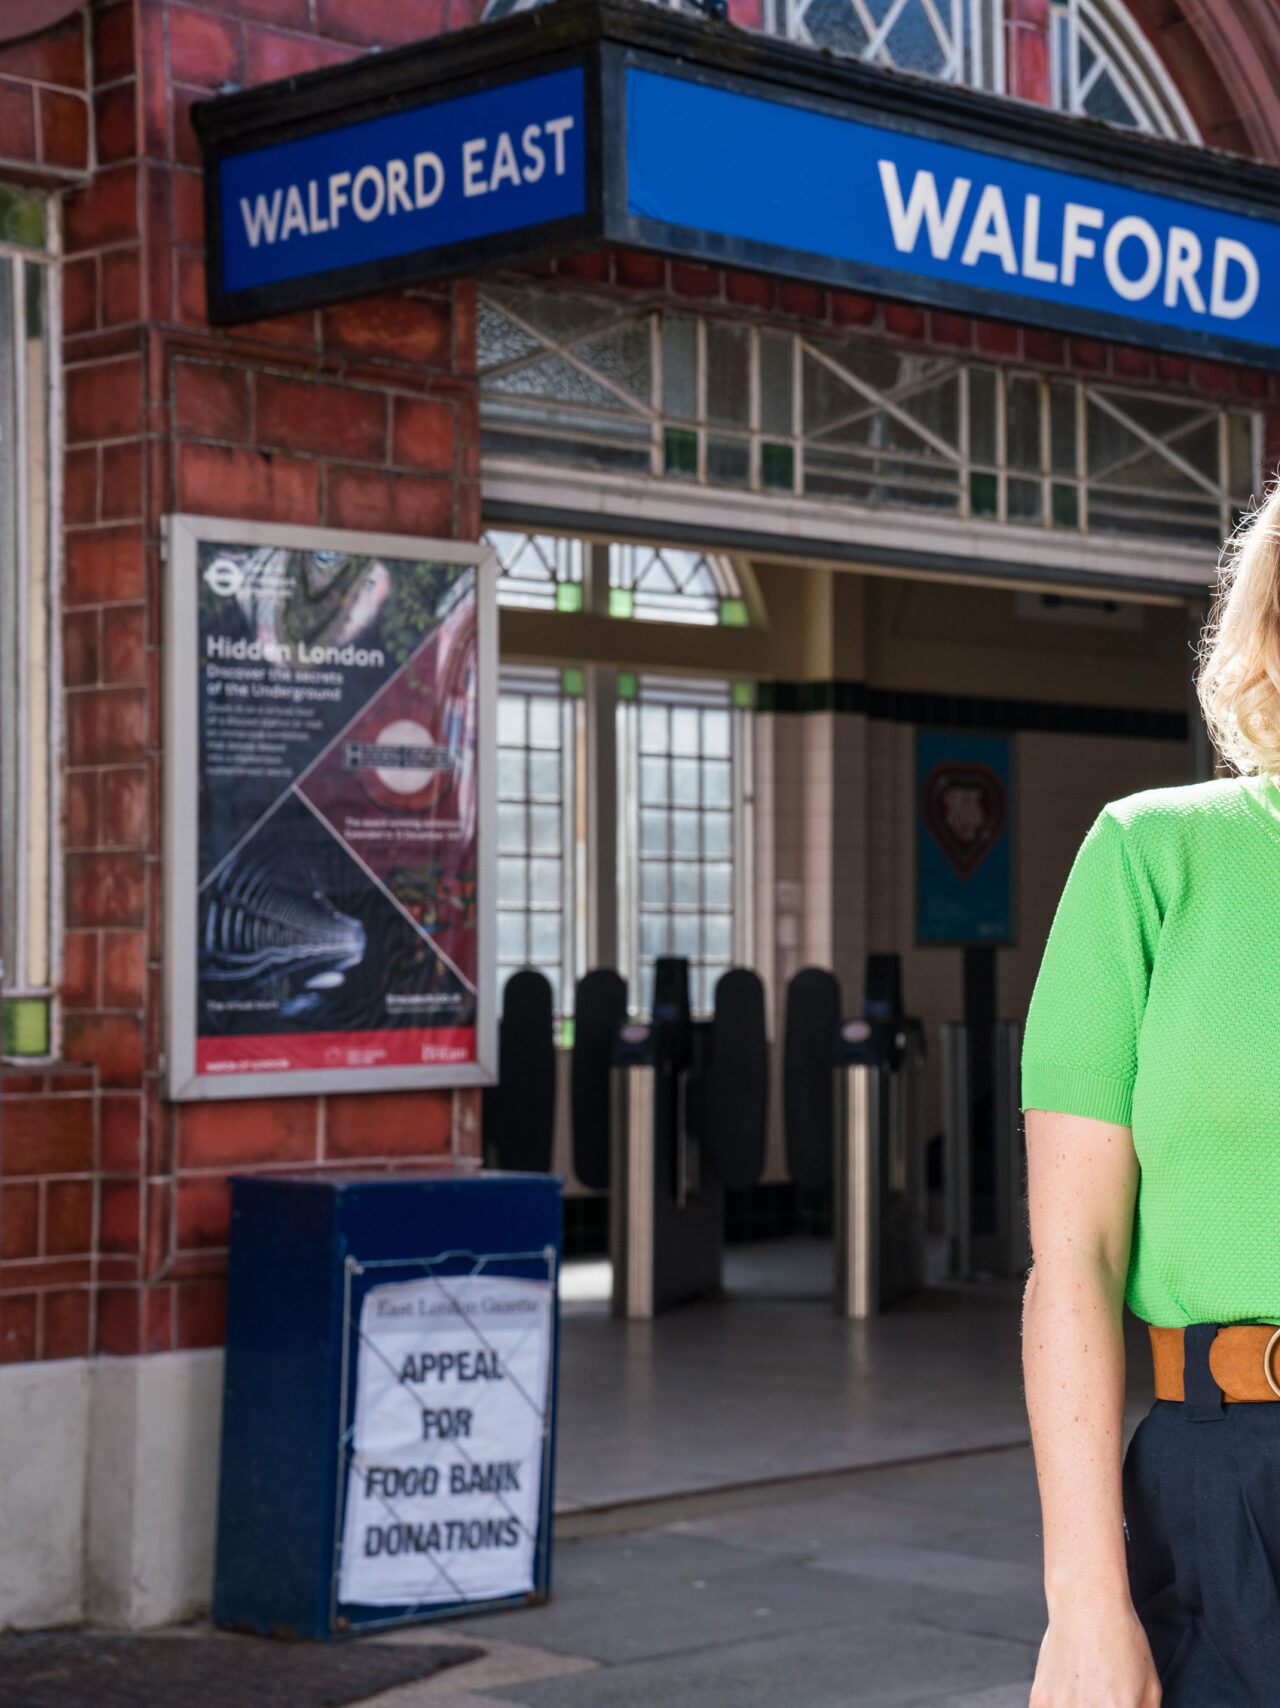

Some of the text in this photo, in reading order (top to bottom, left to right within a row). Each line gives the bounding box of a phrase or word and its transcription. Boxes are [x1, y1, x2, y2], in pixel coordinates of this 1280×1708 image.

[239, 115, 574, 248] WALFORD EAST
[877, 158, 1260, 320] WALFORD
[206, 635, 385, 668] Hidden London
[206, 663, 344, 685] Discover the secrets
[206, 682, 342, 703] of the Underground
[377, 1299, 413, 1318] East
[418, 1296, 477, 1316] London
[399, 1349, 504, 1385] APPEAL
[421, 1407, 473, 1440] FOR
[365, 1459, 523, 1499] FOOD BANK
[364, 1514, 521, 1558] DONATIONS
